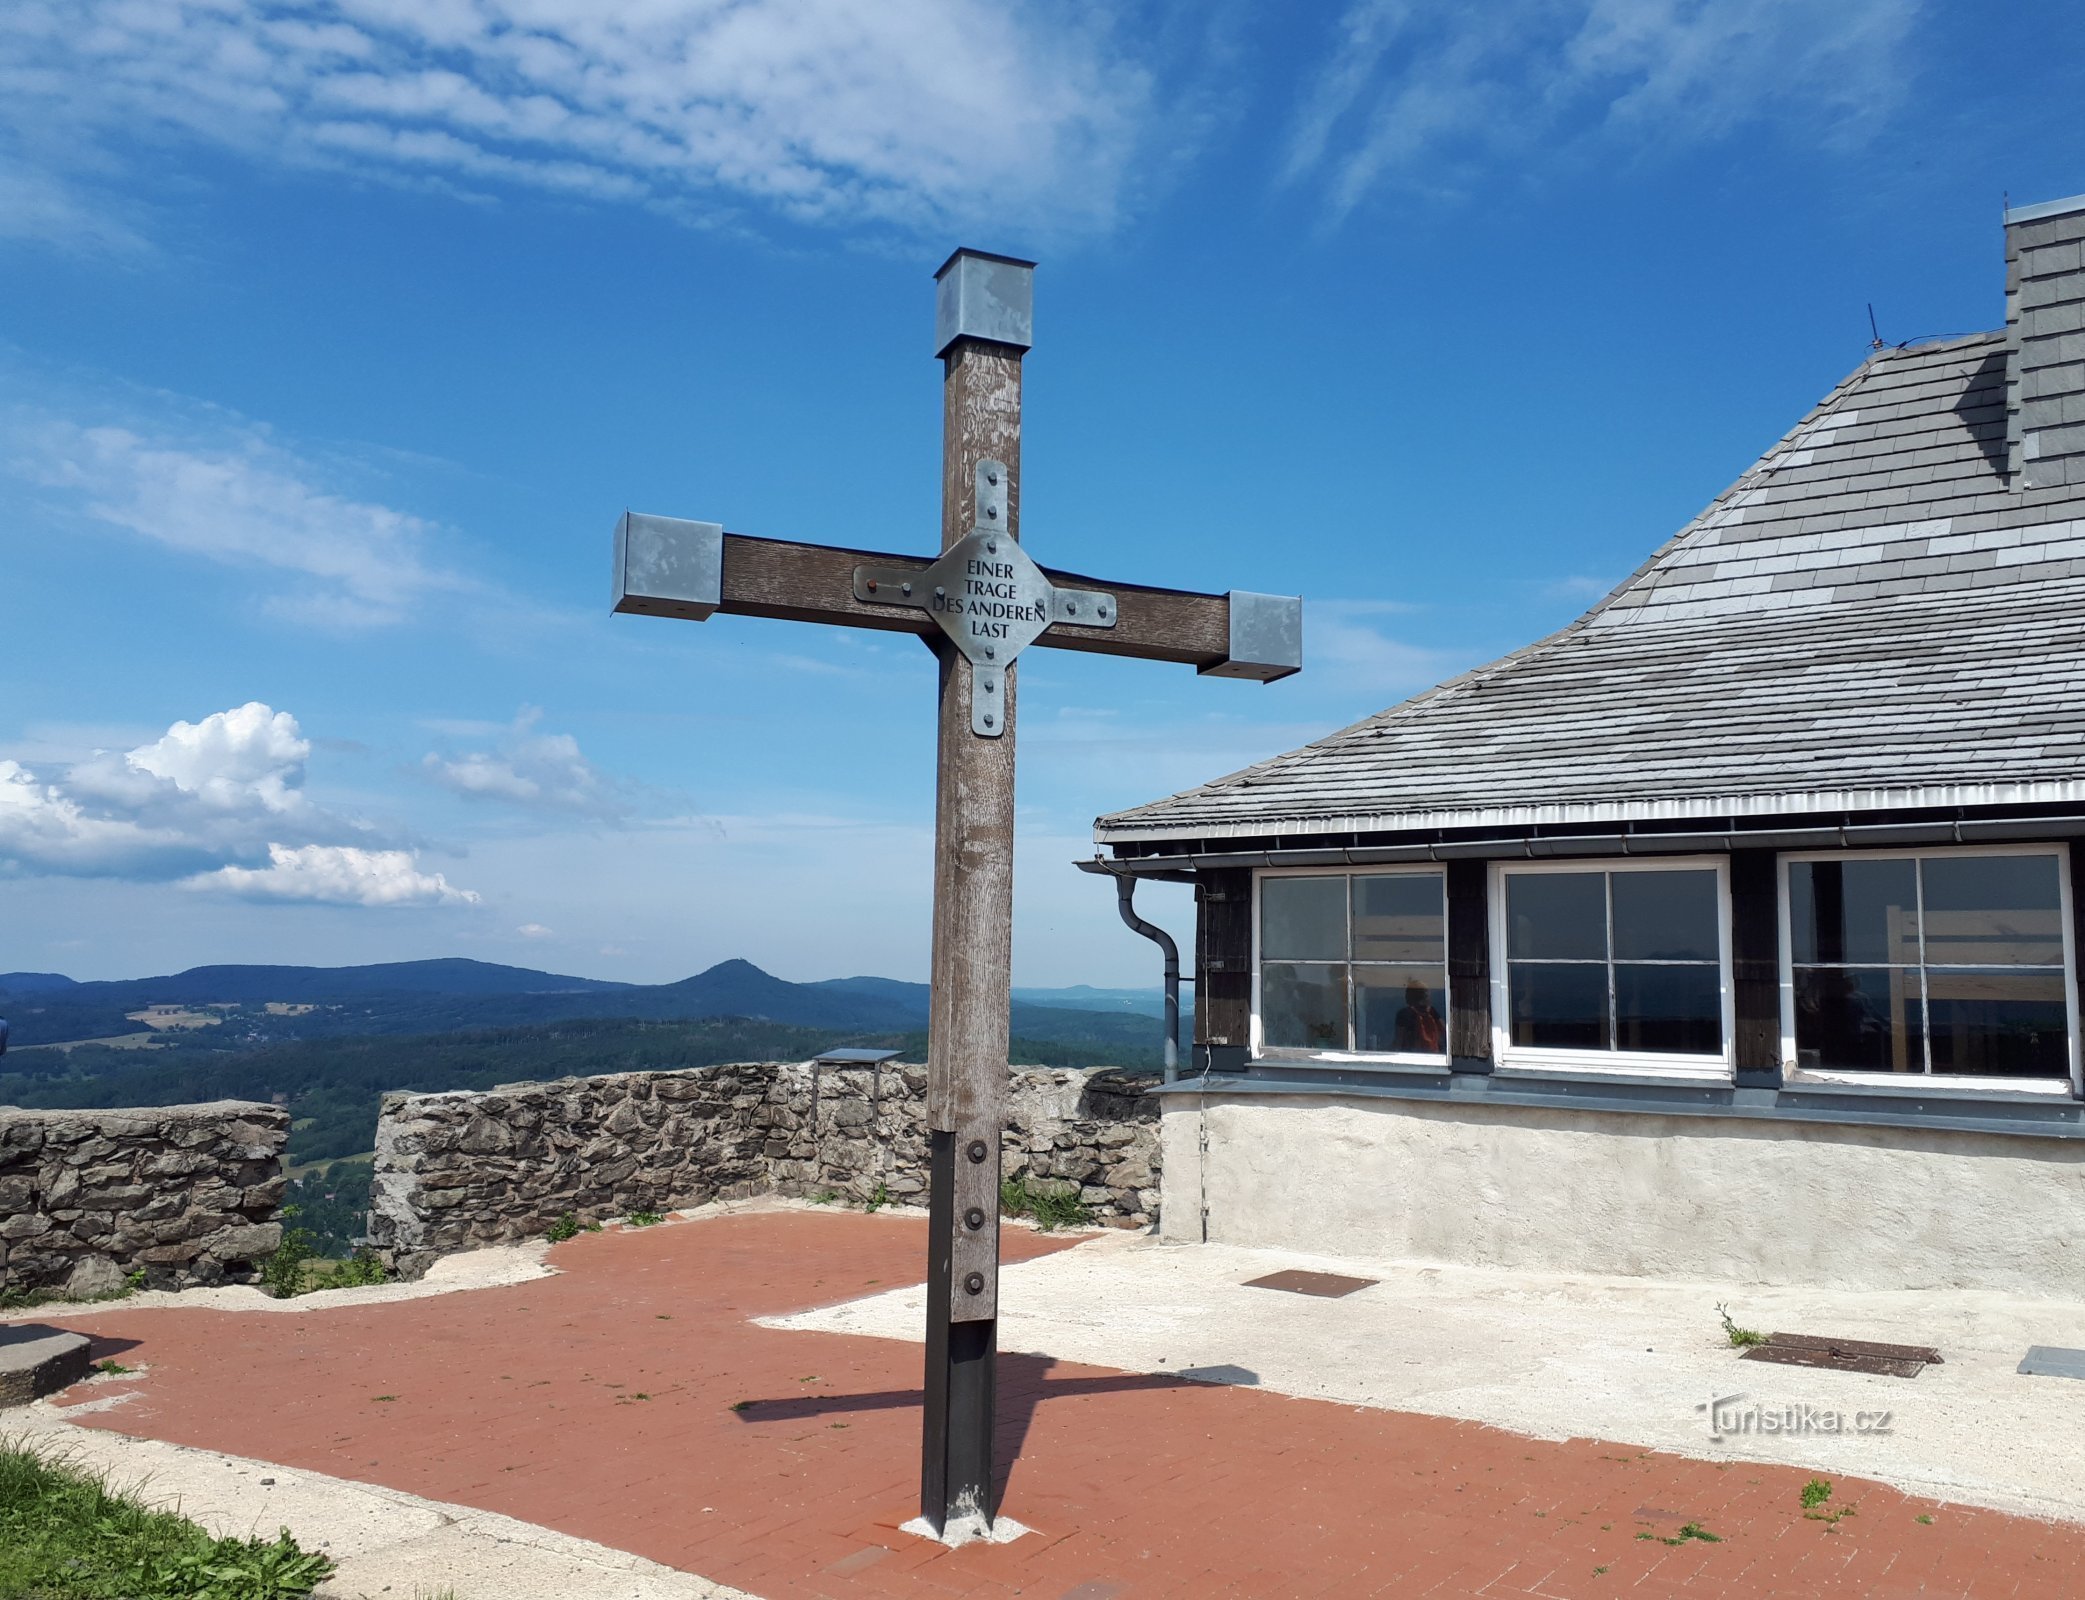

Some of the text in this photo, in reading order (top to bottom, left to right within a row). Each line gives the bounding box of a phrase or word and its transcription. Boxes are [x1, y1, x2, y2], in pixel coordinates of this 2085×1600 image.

[967, 559, 1014, 580] EINER
[964, 579, 1017, 600] TRAGE
[932, 596, 1046, 623] DES ANDEREN
[971, 620, 1010, 639] LAST
